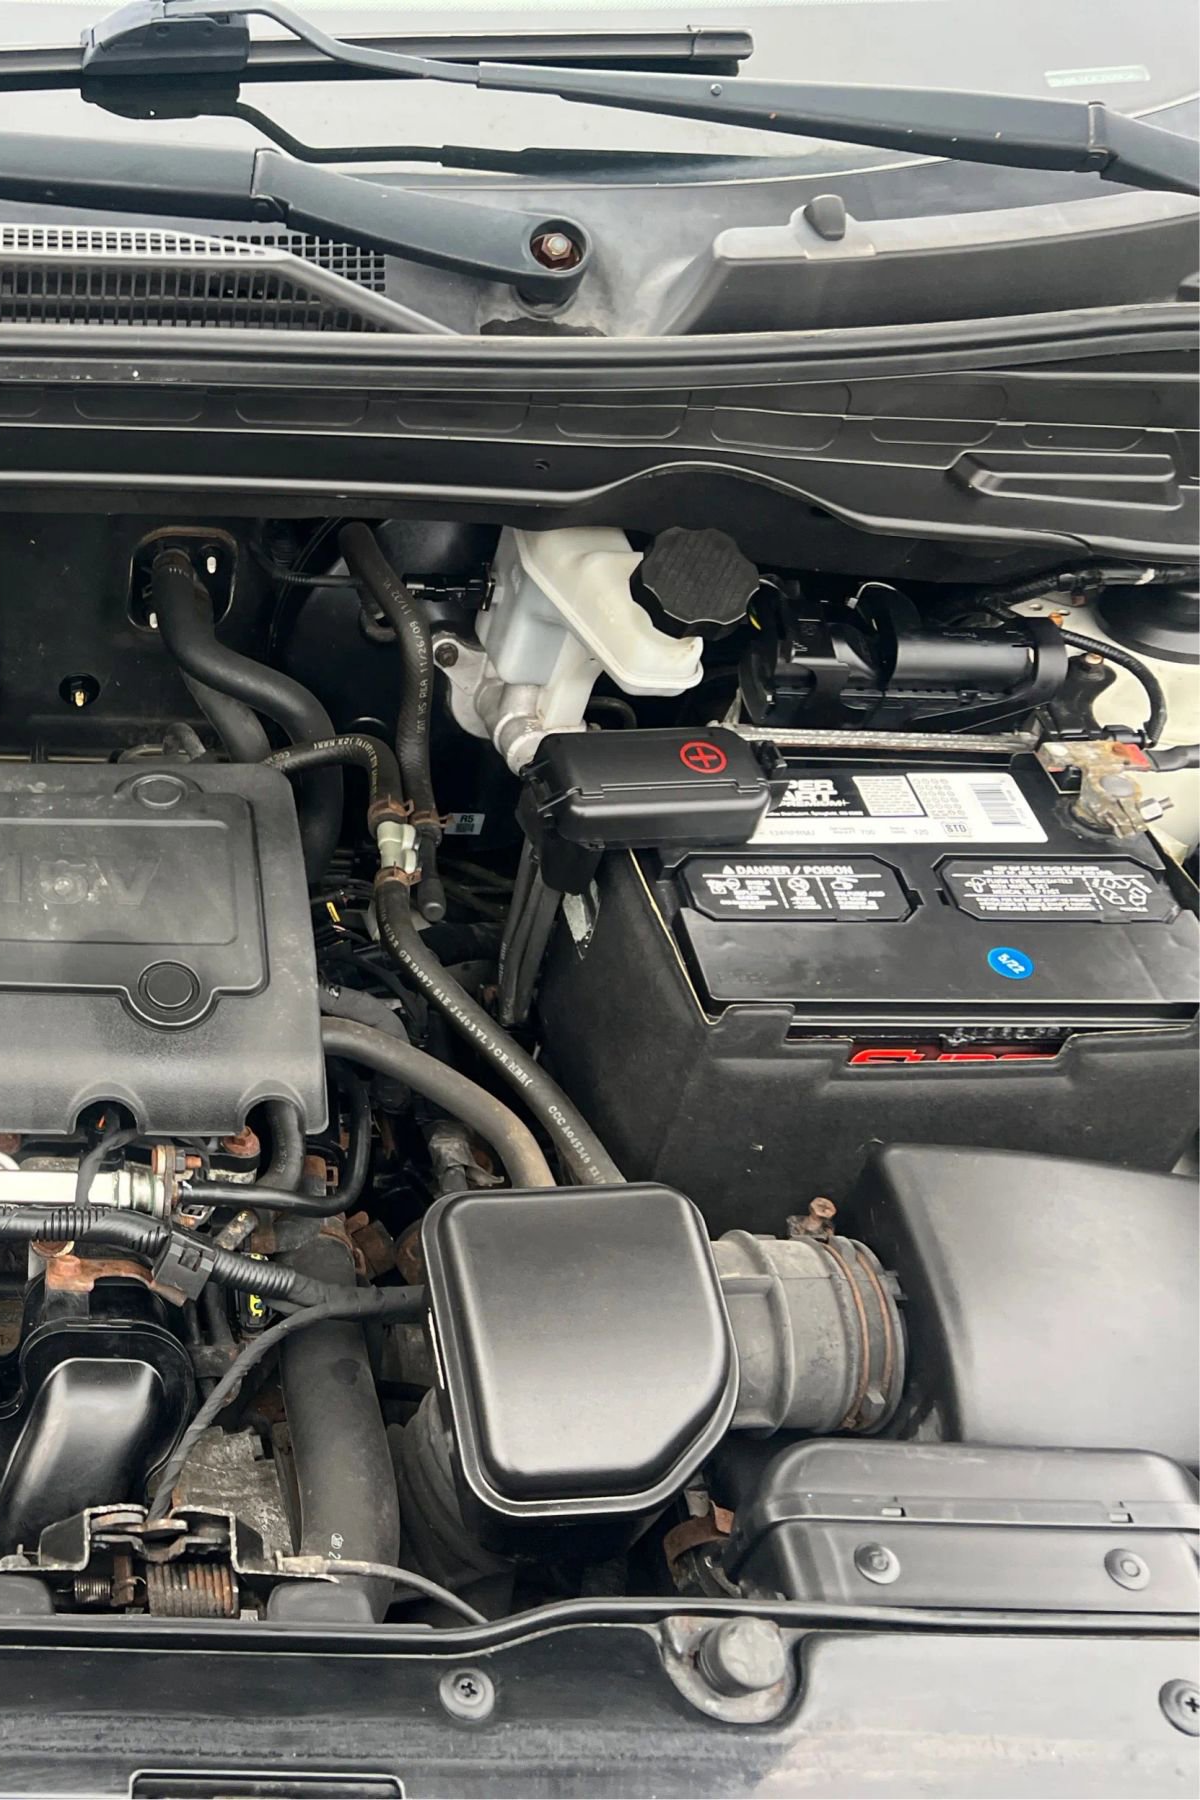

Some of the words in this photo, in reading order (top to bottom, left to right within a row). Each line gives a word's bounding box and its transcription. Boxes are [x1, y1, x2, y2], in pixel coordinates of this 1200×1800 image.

[460, 813, 475, 823] R5
[736, 865, 790, 875] DANGER
[803, 865, 854, 875] POISON
[997, 952, 1026, 975] 5/22
